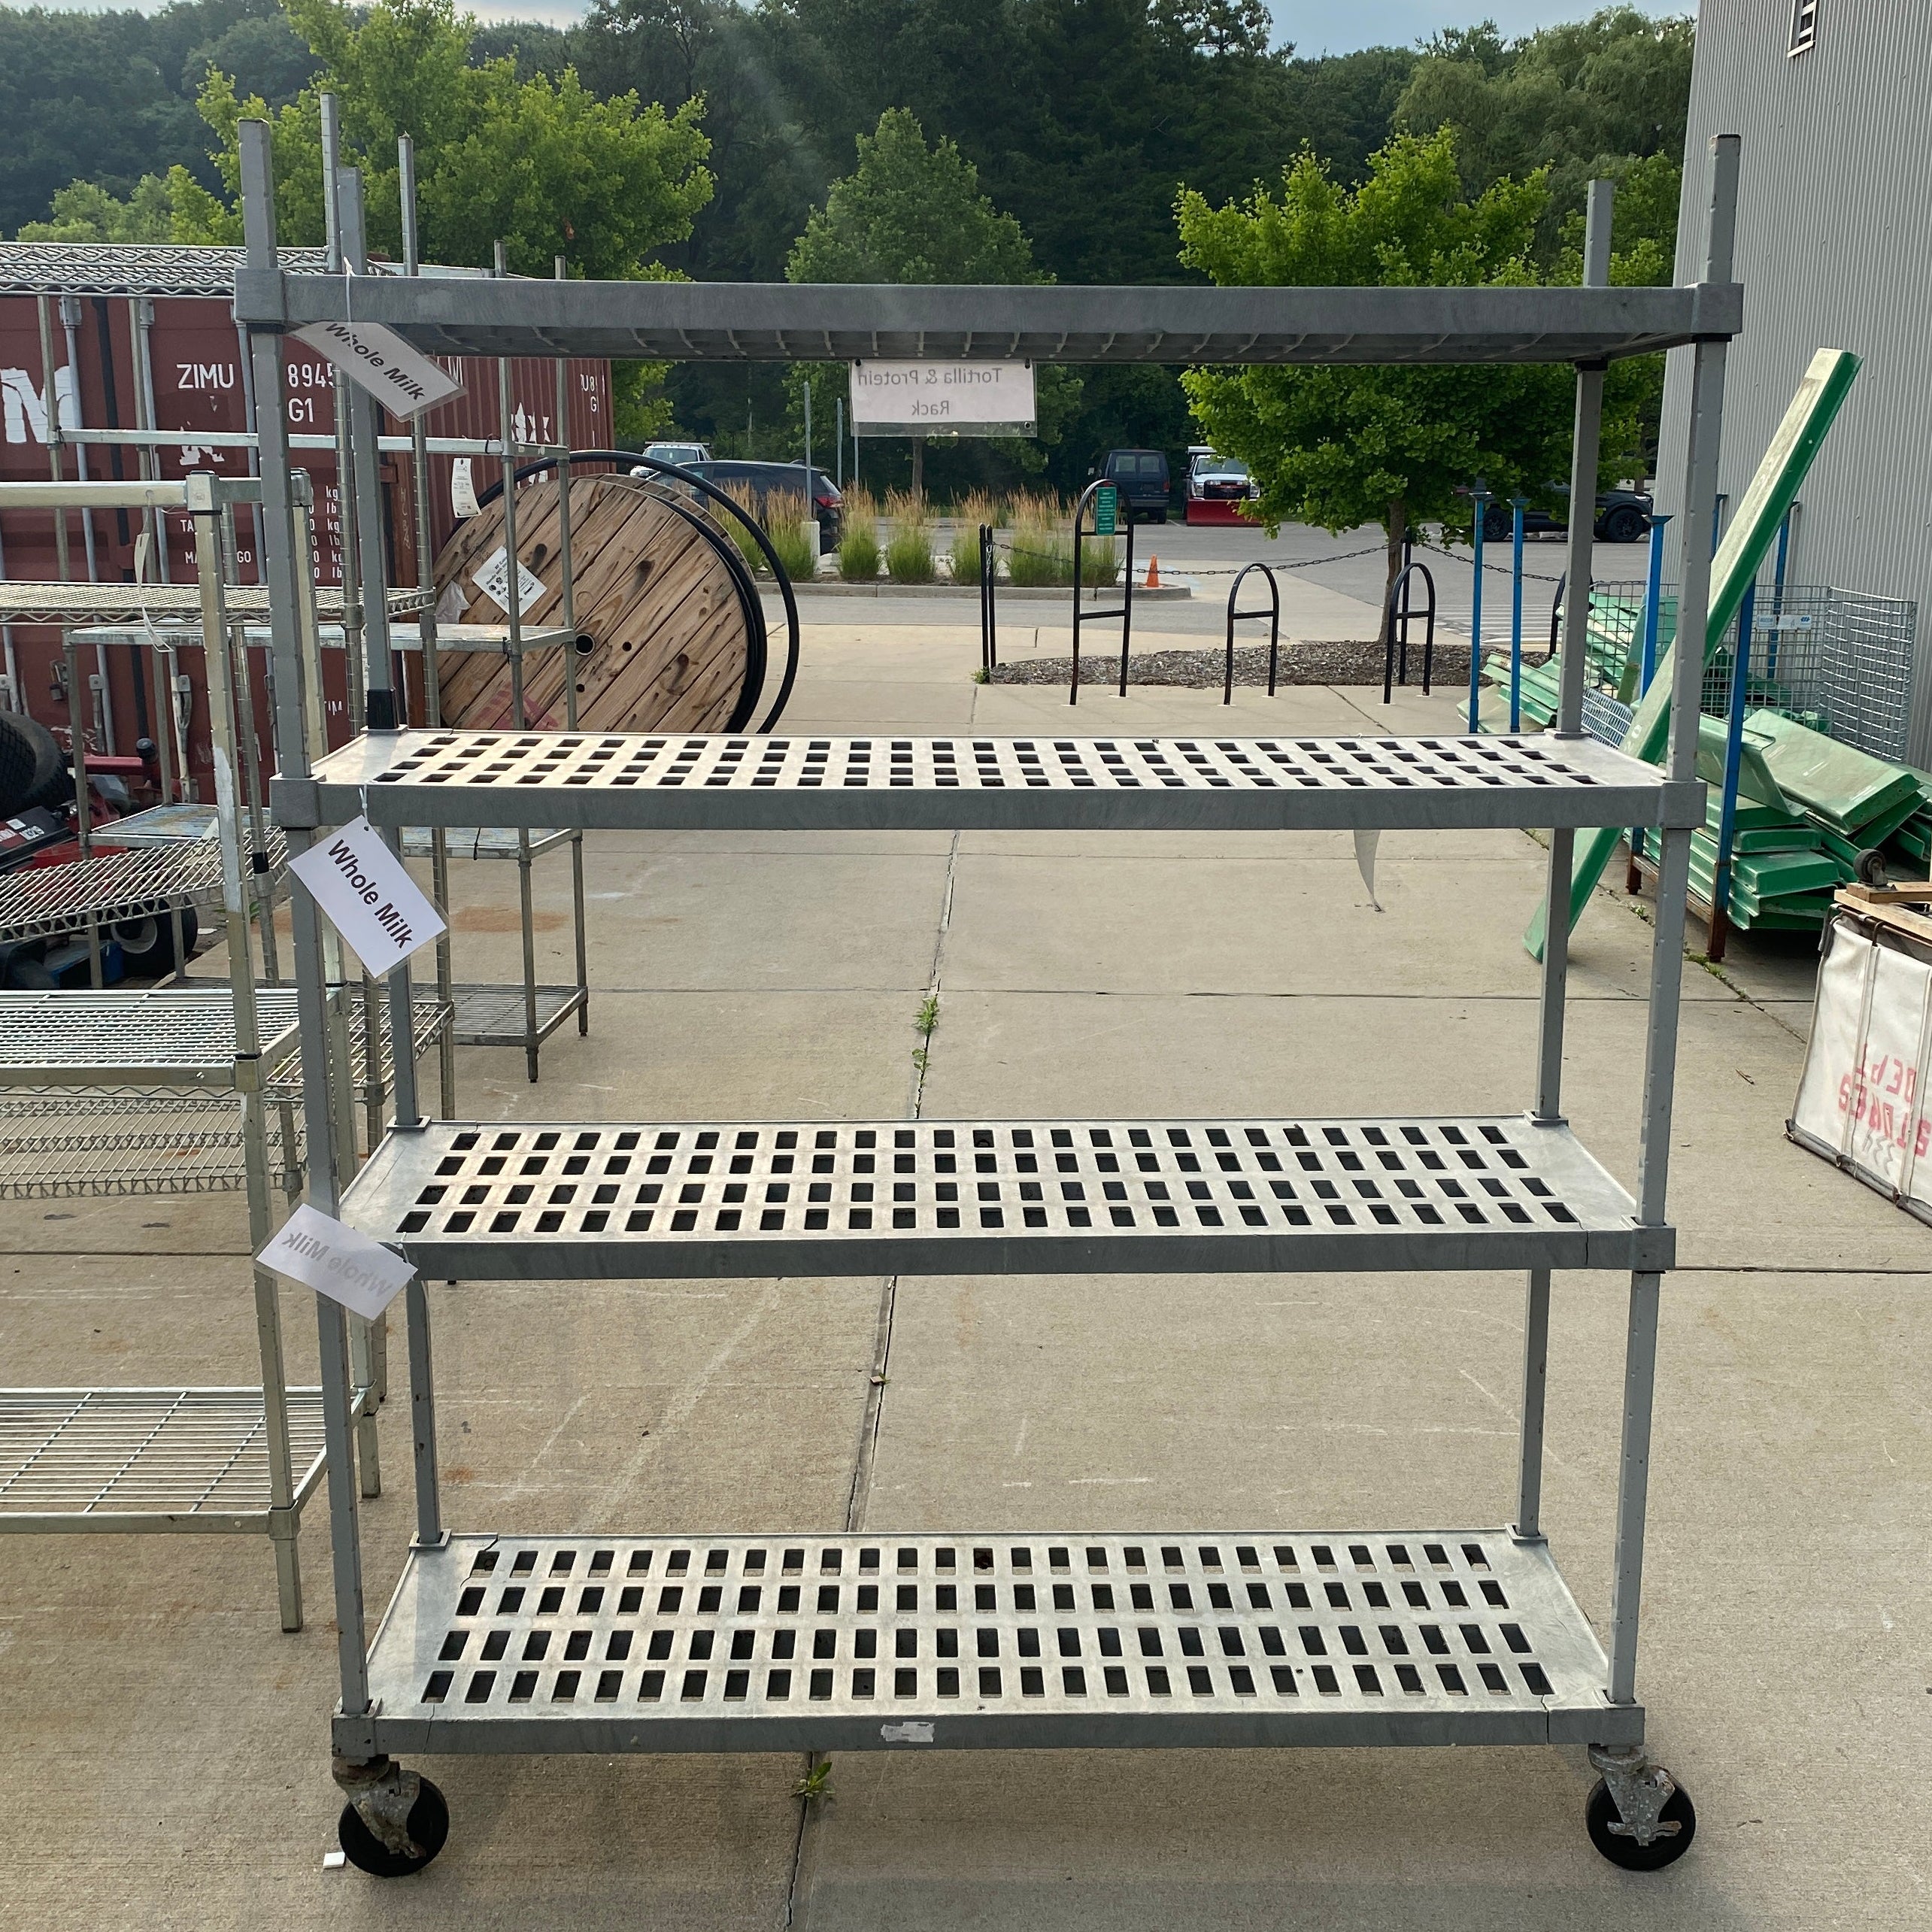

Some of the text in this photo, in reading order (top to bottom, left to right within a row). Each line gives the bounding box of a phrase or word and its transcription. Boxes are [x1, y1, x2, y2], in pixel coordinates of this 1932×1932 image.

[326, 323, 384, 367] Whole
[384, 367, 425, 400] Milk
[176, 363, 235, 389] ZIMU
[326, 485, 338, 502] kg
[326, 502, 336, 514] lb
[327, 518, 339, 533] kg
[329, 535, 340, 546] lb
[332, 566, 342, 578] lb
[328, 839, 413, 949] Whole Milk
